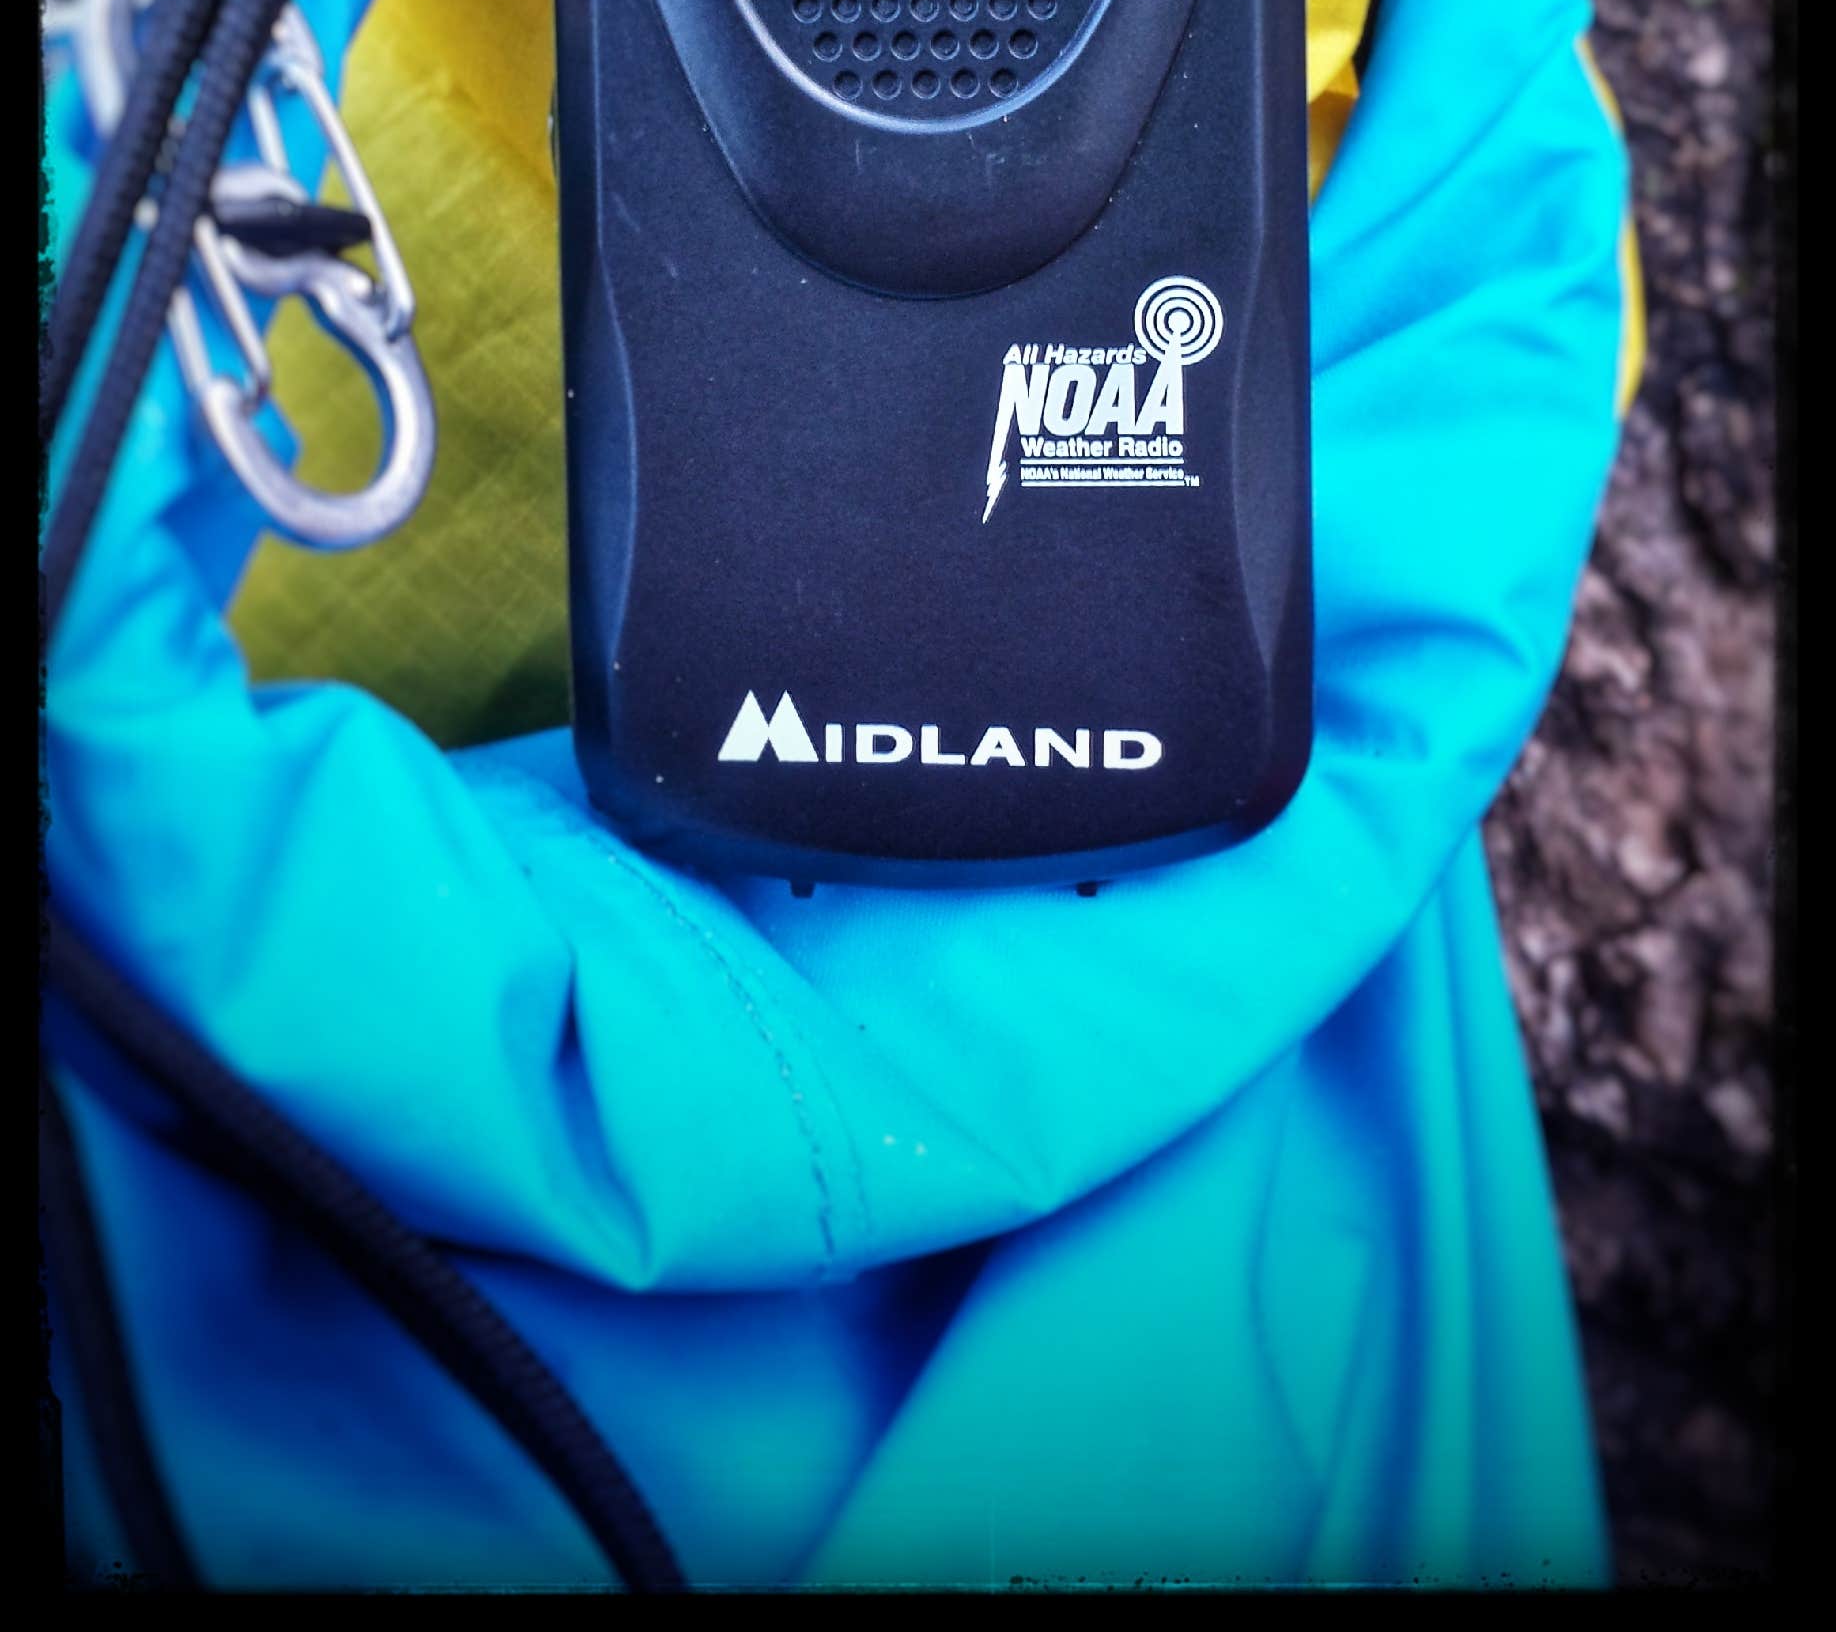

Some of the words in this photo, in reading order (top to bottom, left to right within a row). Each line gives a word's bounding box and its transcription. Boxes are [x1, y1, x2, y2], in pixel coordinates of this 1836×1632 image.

[1002, 343, 1040, 365] All
[1044, 343, 1148, 365] Hazards
[994, 363, 1184, 436] NOAA
[1020, 436, 1112, 457] Weather
[1118, 436, 1183, 457] Radio
[1020, 466, 1059, 480] NOAA's
[1060, 466, 1101, 480] National
[1103, 466, 1144, 480] Weather
[1146, 466, 1184, 480] Service
